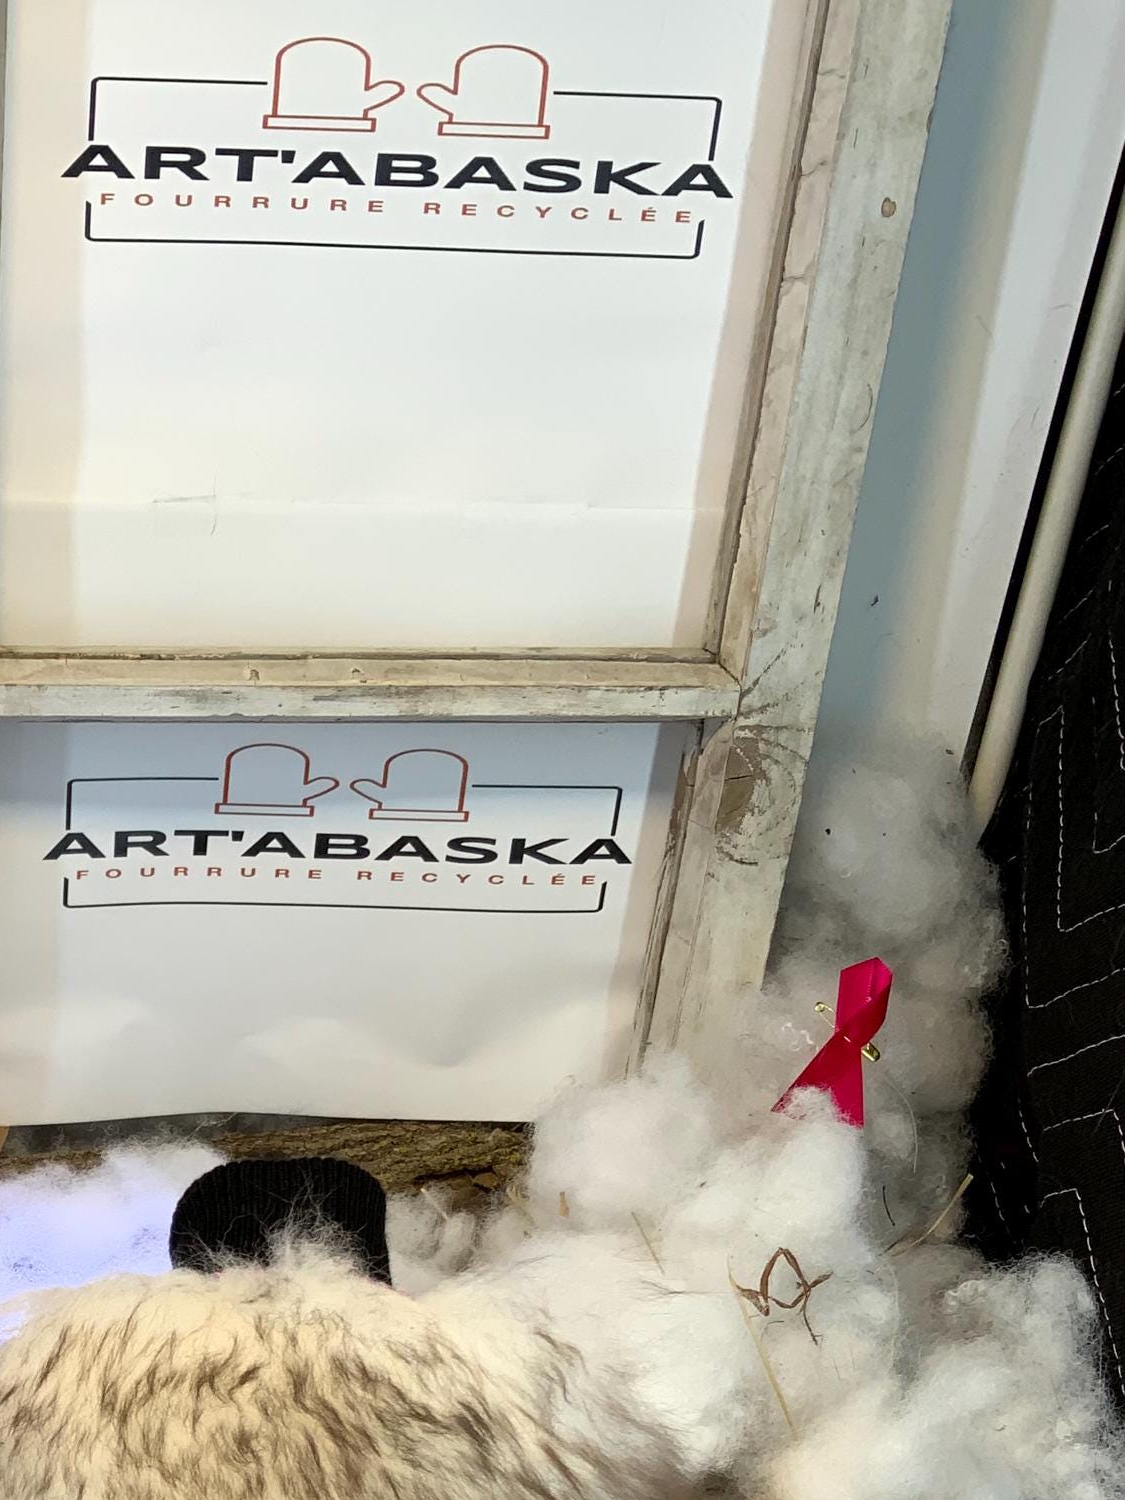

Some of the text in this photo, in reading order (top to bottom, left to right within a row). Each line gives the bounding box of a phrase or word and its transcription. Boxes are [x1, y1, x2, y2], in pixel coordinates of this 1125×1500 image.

[61, 144, 734, 199] ART'ABASKA
[99, 192, 693, 224] FOURRURE RECYCLÉE
[42, 829, 632, 865] ART'ABASKA
[77, 866, 596, 887] FOURRURE RECYCLÉE
